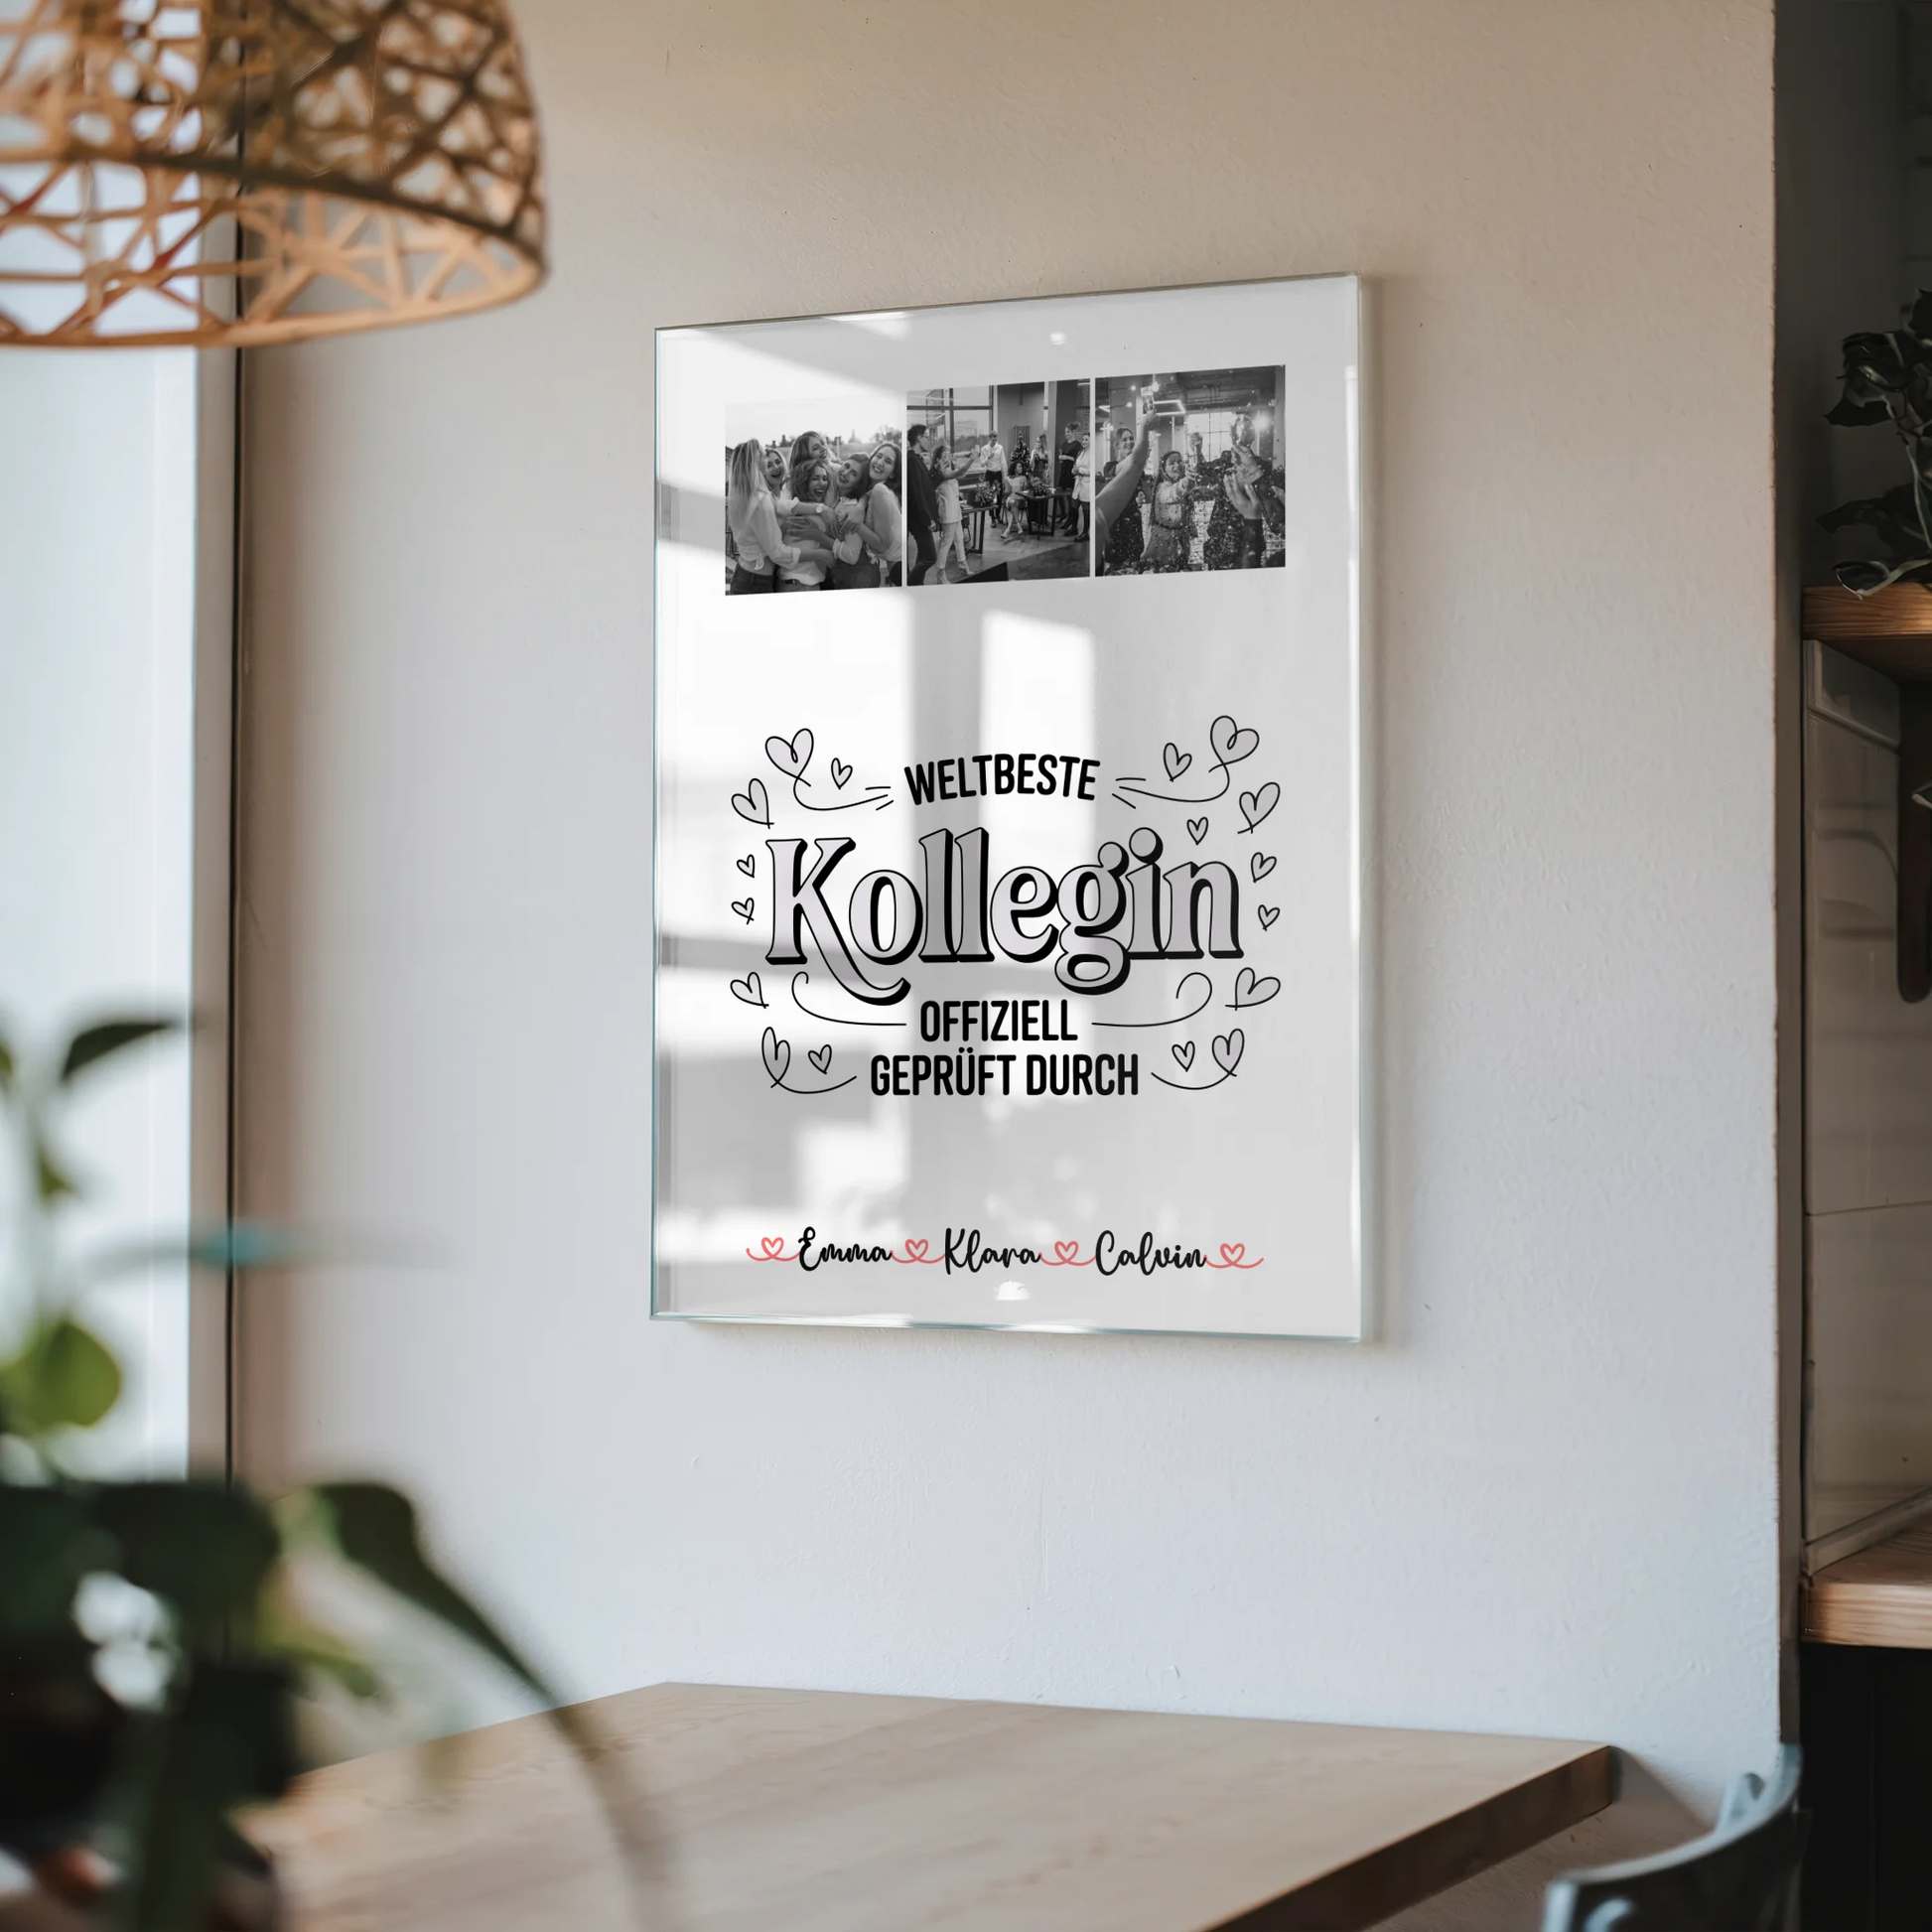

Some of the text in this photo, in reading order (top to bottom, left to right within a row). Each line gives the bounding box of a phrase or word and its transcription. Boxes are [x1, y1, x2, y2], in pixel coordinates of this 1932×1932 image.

[903, 753, 1101, 806] WELTBESTE
[764, 826, 1245, 1007] Kollegin
[919, 999, 1079, 1042] OFFIZIELL
[870, 1046, 1140, 1096] GEPRÜFT DURCH
[797, 1226, 1207, 1277] Emma Klara Calvin
